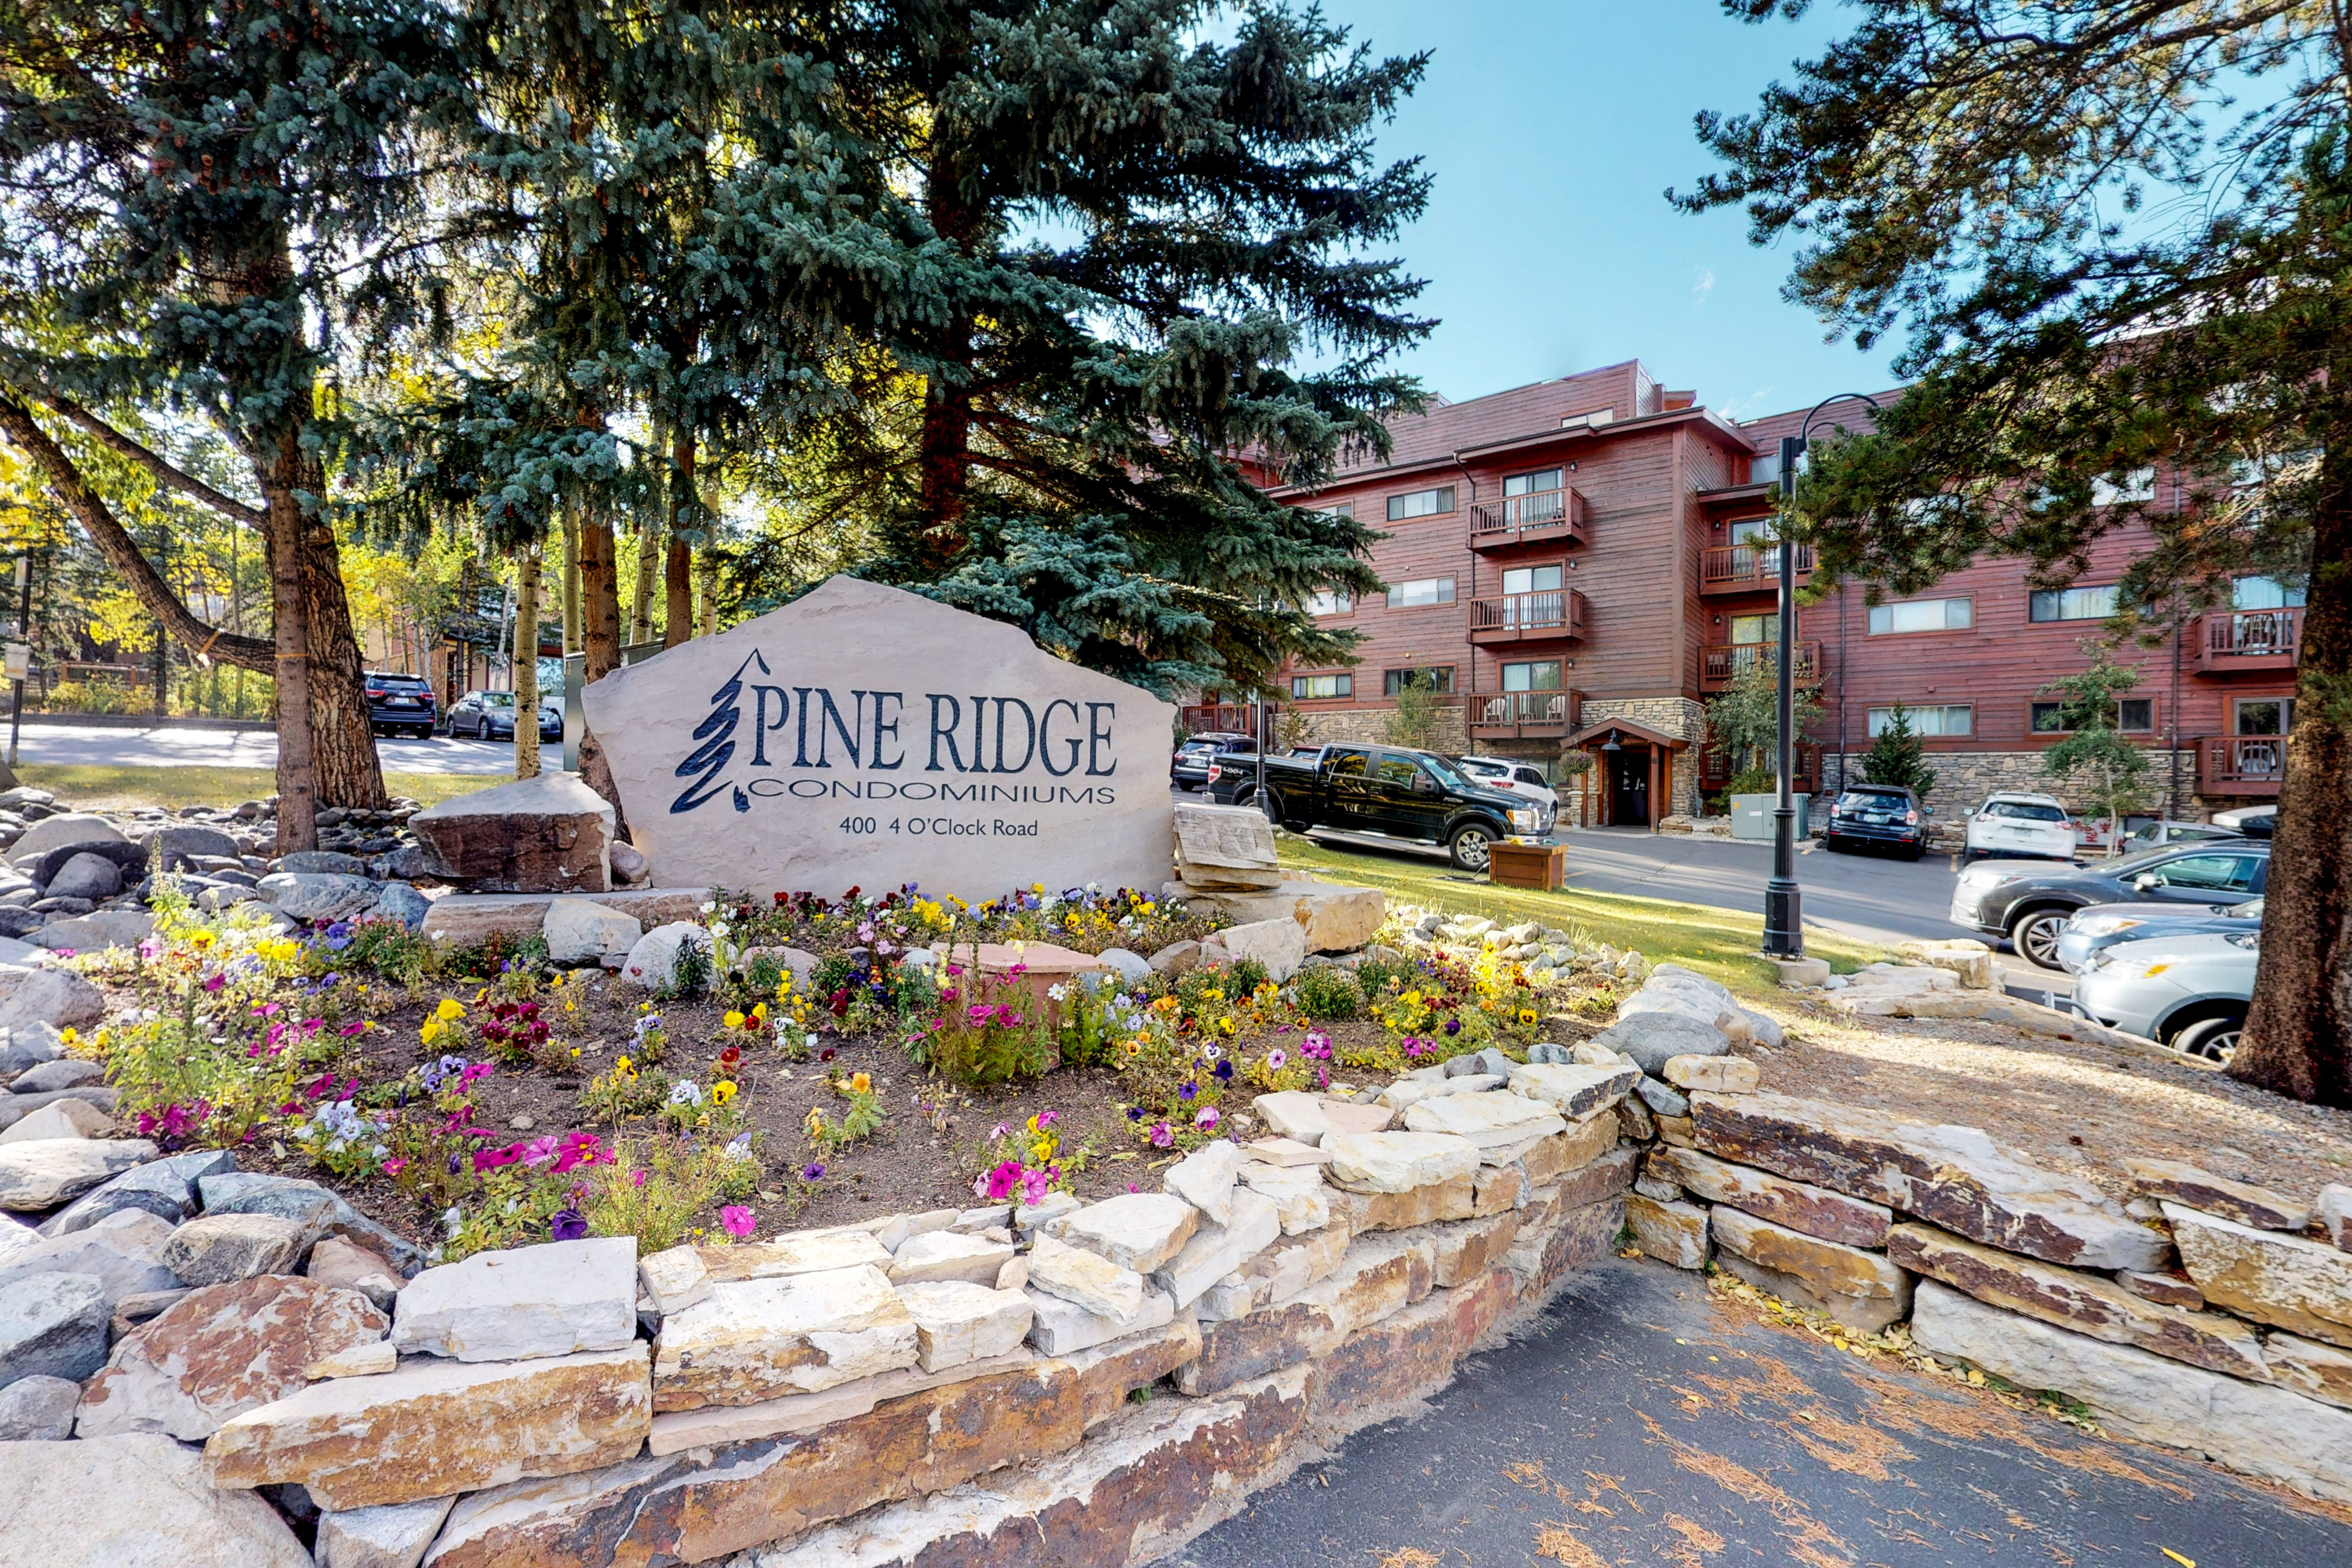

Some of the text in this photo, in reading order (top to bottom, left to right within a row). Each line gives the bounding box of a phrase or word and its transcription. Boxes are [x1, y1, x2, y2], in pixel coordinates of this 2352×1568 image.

[750, 685, 1118, 777] PINE RIDGE
[747, 778, 1116, 805] CONDOMINIUMS
[839, 817, 1038, 836] 400 4 O'Clock Road
